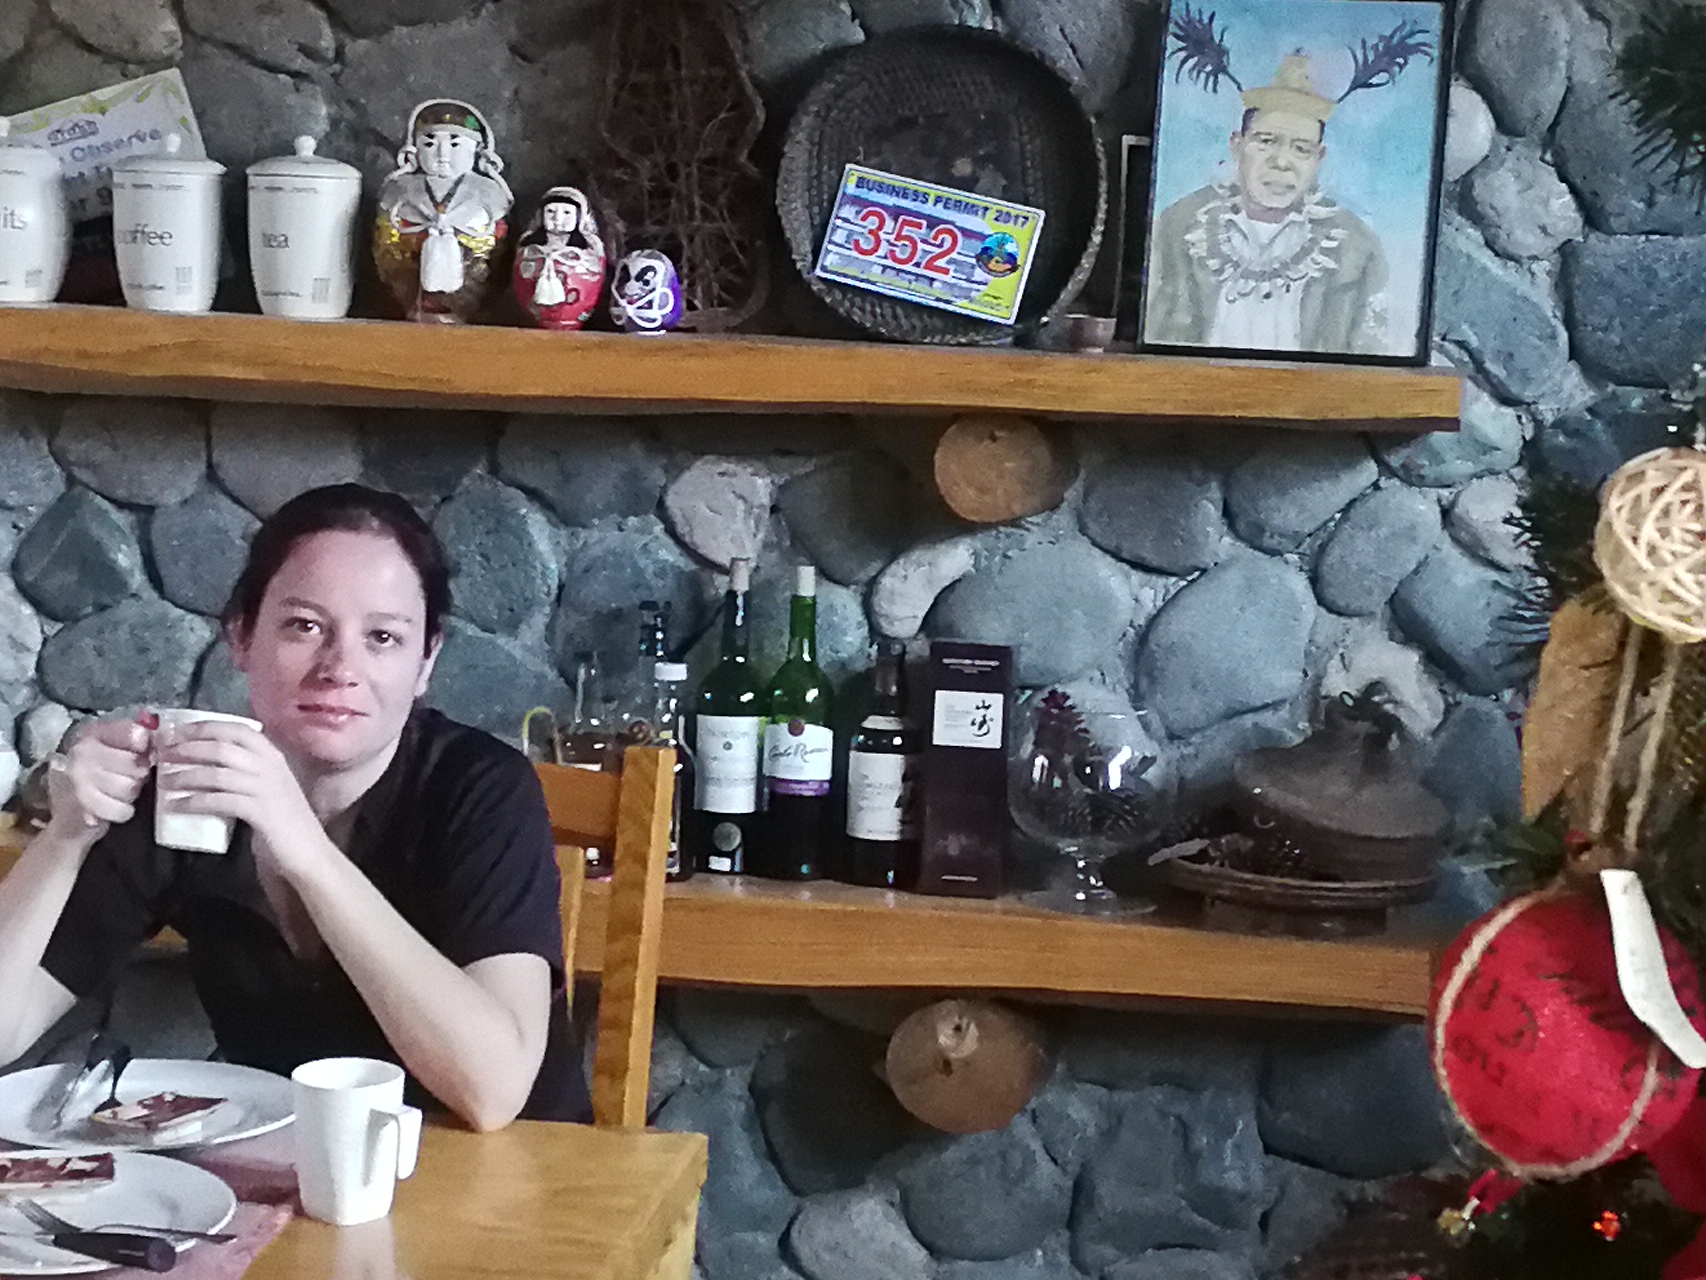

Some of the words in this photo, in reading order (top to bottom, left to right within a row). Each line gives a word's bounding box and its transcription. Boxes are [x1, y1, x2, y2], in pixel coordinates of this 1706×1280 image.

[70, 127, 163, 163] Observe
[854, 175, 930, 206] BUSINESS
[932, 194, 991, 220] PERMIT
[992, 209, 1031, 230] 2017
[261, 231, 290, 249] tea
[851, 208, 960, 277] 352
